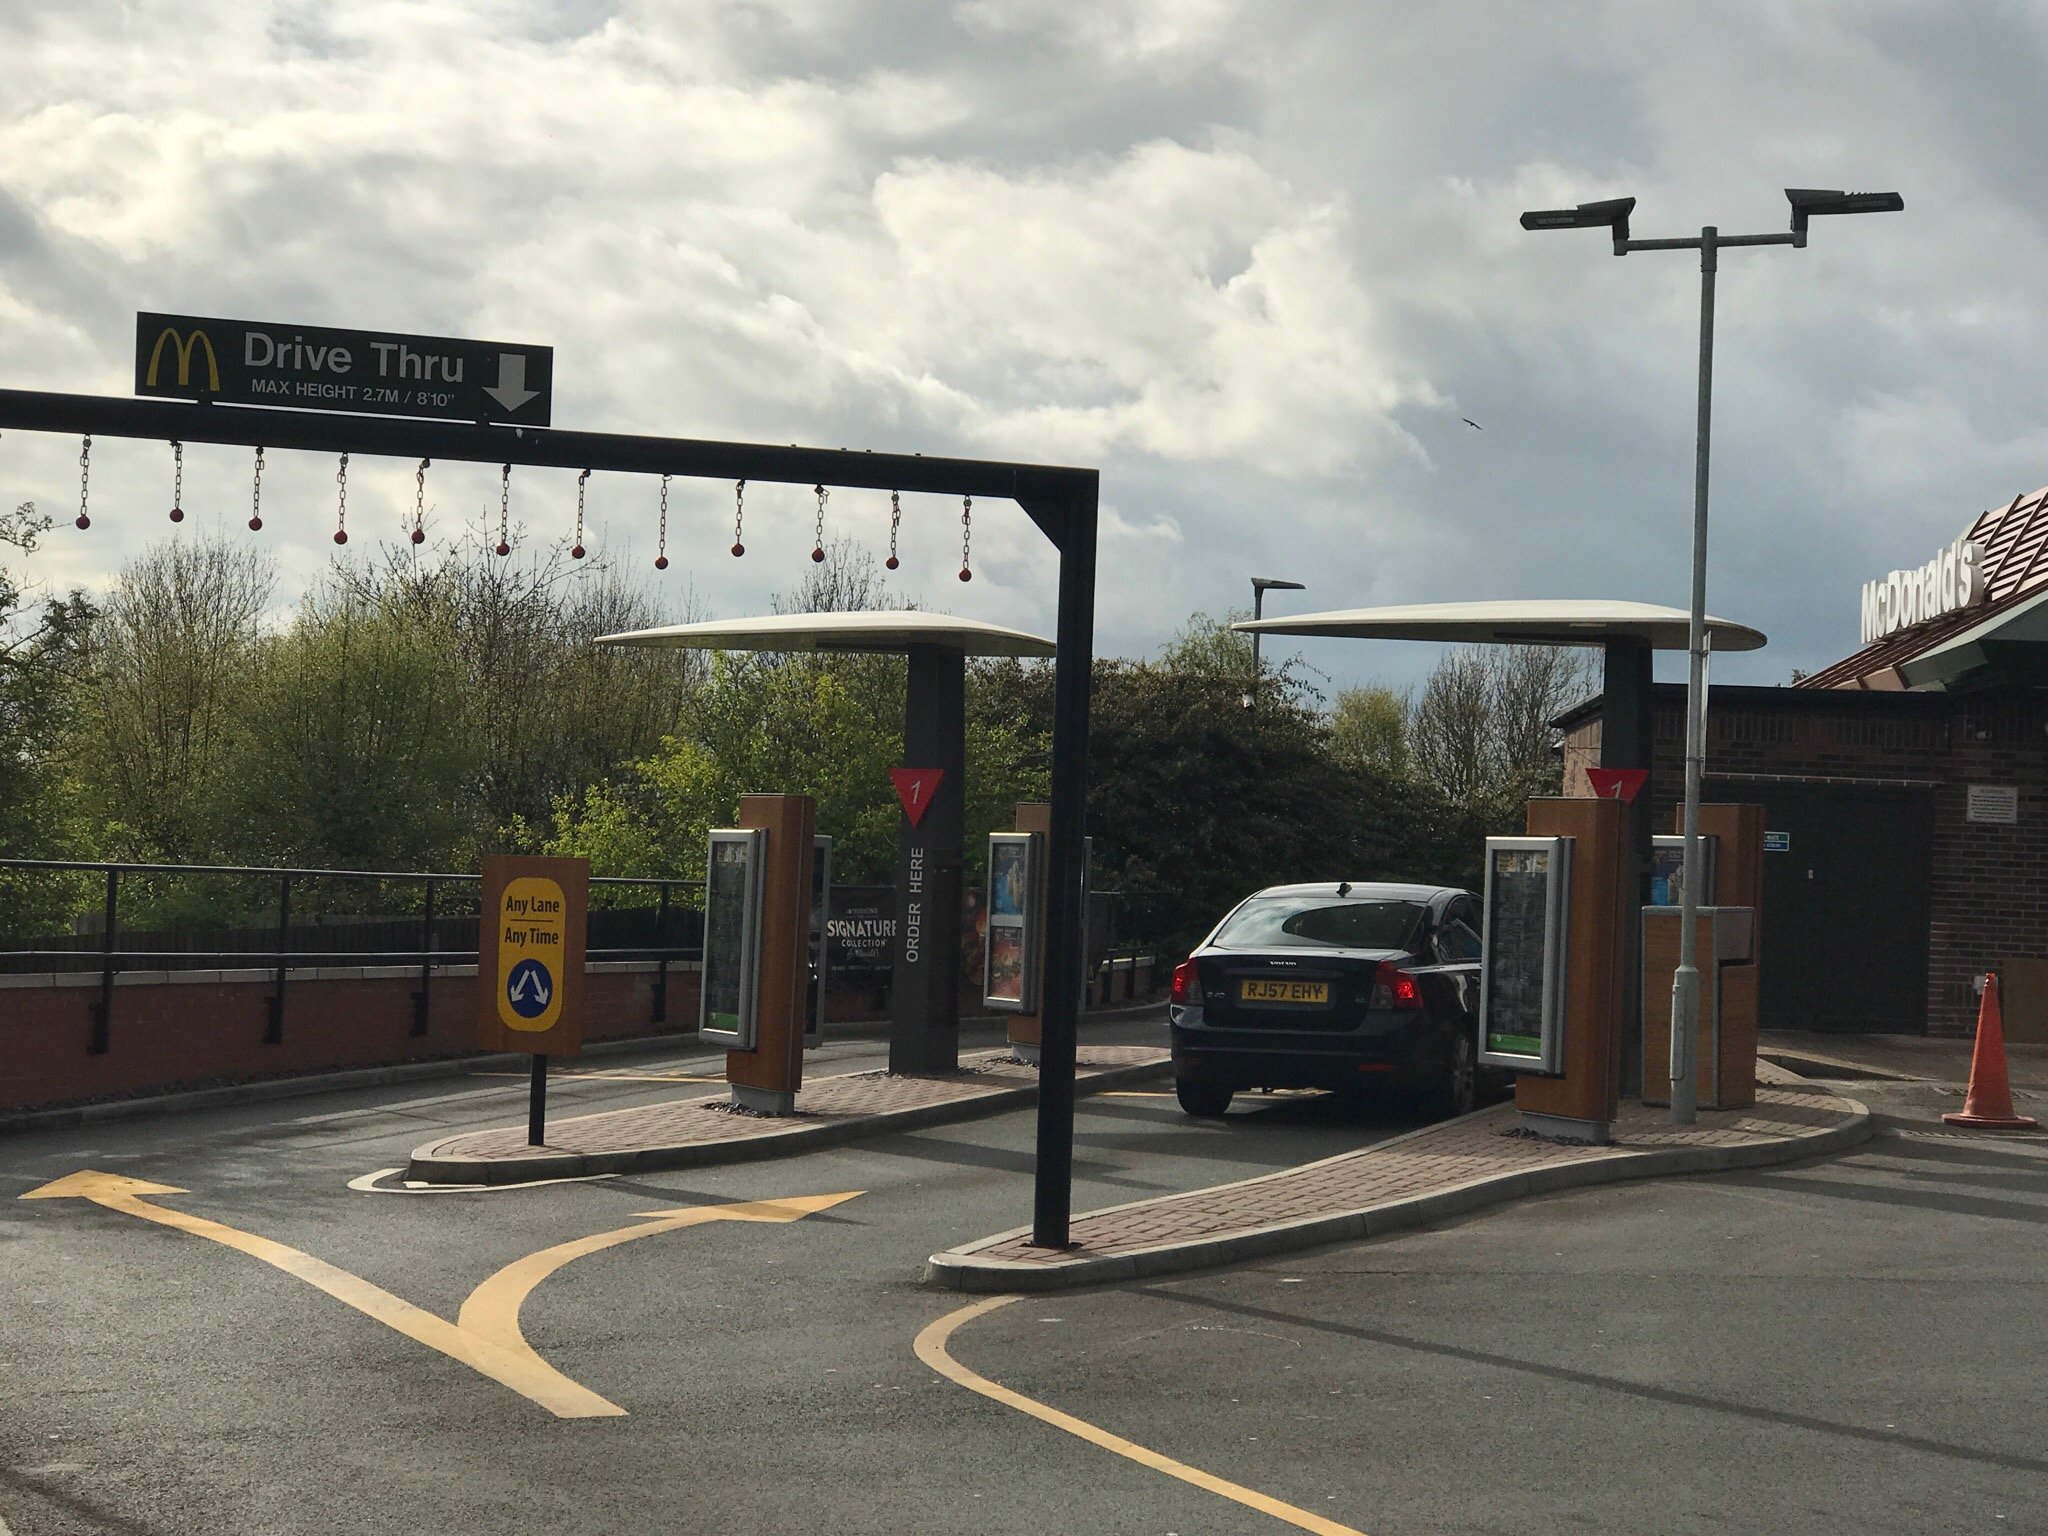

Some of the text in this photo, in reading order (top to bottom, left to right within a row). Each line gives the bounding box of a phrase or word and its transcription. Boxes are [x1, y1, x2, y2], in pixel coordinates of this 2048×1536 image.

[244, 331, 464, 384] Drive Thru
[251, 378, 291, 396] MAX
[296, 381, 357, 401] HEIGHT
[362, 387, 399, 404] 2.7M
[1861, 540, 1984, 645] McDonald's
[910, 780, 921, 805] 1
[505, 895, 560, 915] Any Lane
[906, 847, 925, 964] ORDER HERE
[504, 927, 559, 947] Any Time
[841, 939, 886, 948] COLLECTION
[1247, 982, 1323, 1000] RJ57 EHY
